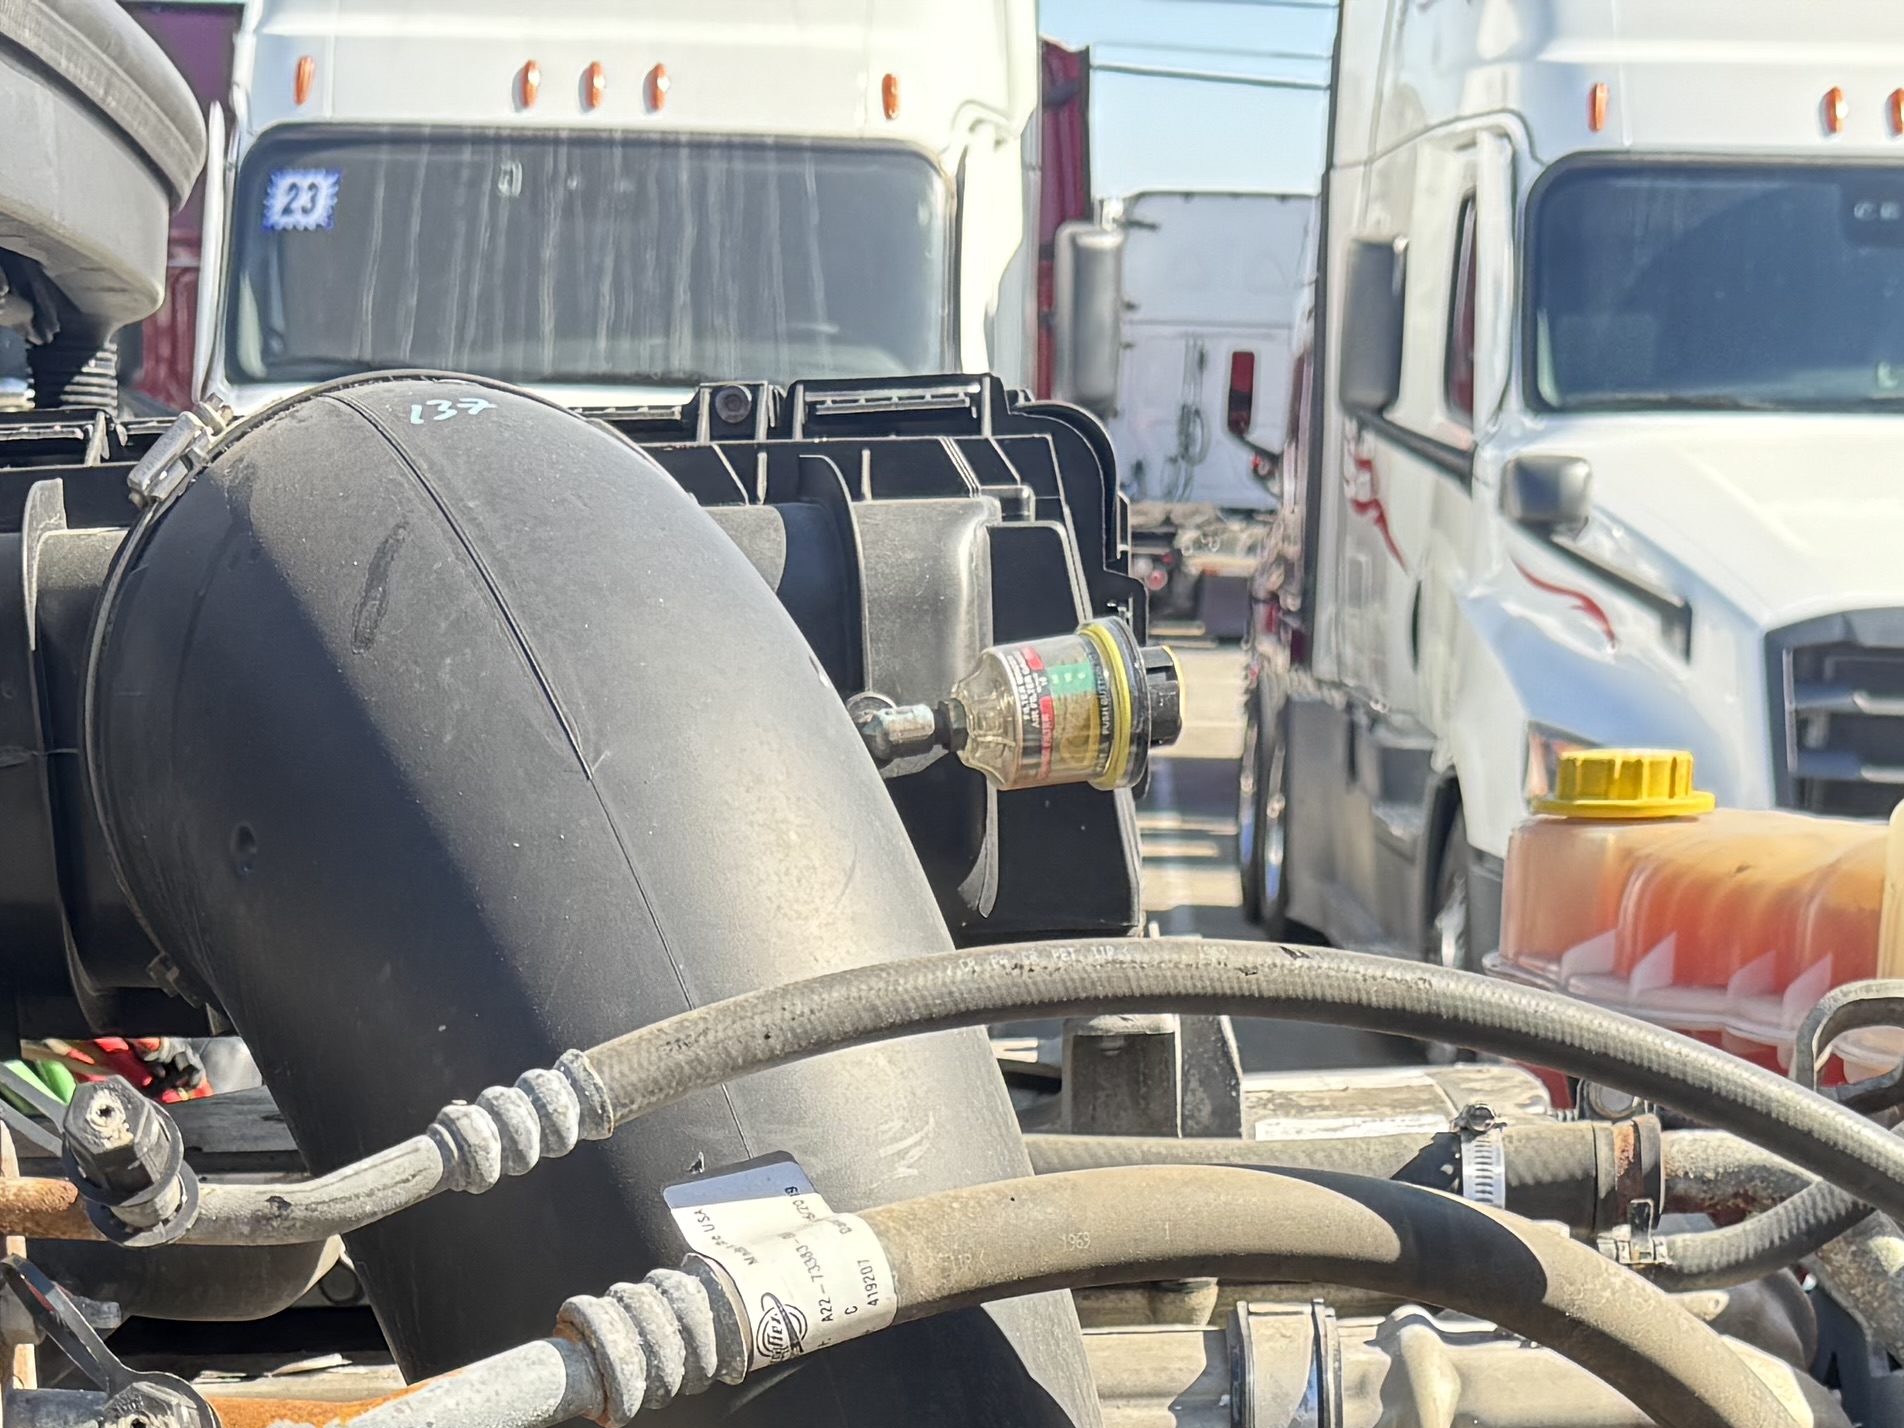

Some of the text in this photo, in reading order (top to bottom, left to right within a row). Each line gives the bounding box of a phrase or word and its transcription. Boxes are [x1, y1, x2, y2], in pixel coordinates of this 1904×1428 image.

[281, 181, 319, 216] 23
[857, 1258, 880, 1307] 419207
[844, 1304, 859, 1316] C
